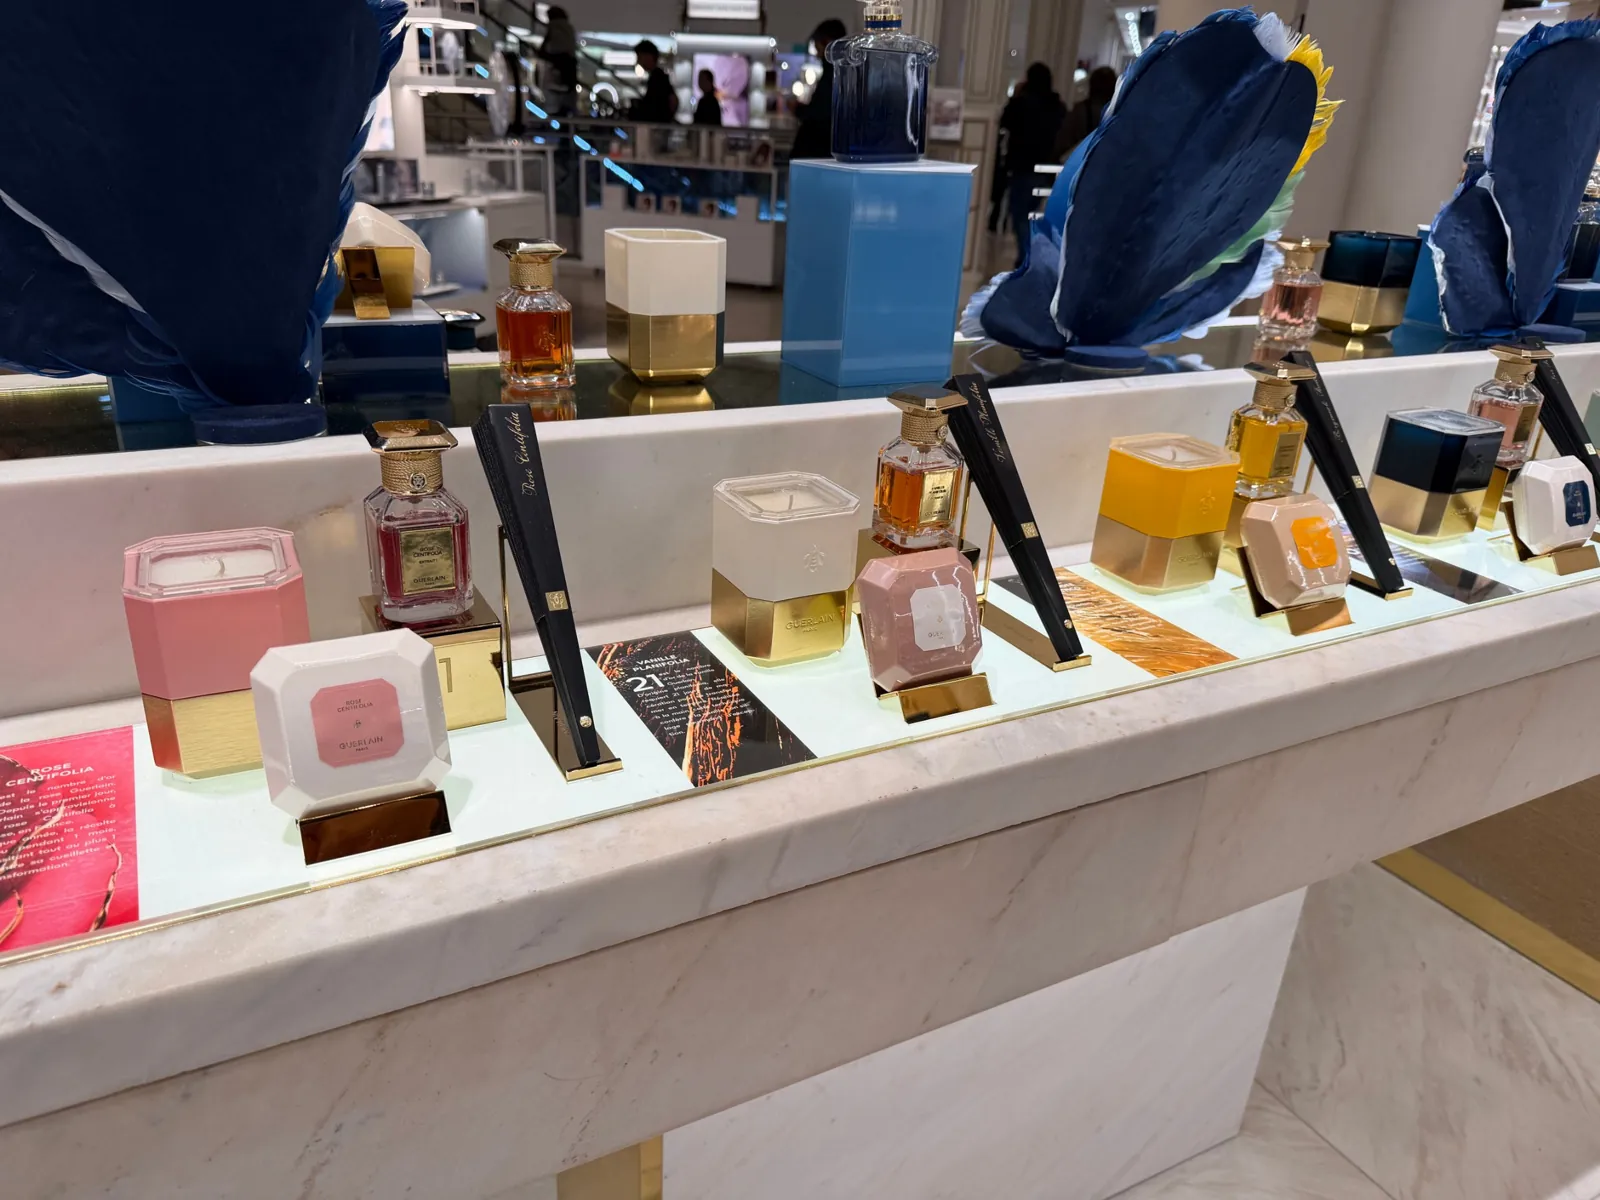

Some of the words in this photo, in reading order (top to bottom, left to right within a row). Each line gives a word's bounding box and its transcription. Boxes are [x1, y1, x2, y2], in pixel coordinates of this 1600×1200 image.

[504, 412, 530, 464] Centifolia
[522, 468, 538, 496] Rose
[413, 576, 446, 584] GUERLAIN
[786, 613, 835, 630] GUERLAIN
[632, 658, 690, 672] PLANIFOLIA
[626, 673, 665, 692] 21
[337, 702, 373, 712] CENTIFOLIA
[339, 736, 383, 750] GUERLAIN
[30, 763, 71, 775] ROSE
[5, 766, 94, 787] CENTIFOLIA
[47, 780, 86, 791] nombre
[4, 821, 27, 830] rose
[80, 820, 116, 830] récolte
[39, 846, 61, 855] tout
[84, 837, 107, 847] plus
[49, 847, 100, 862] cueillette
